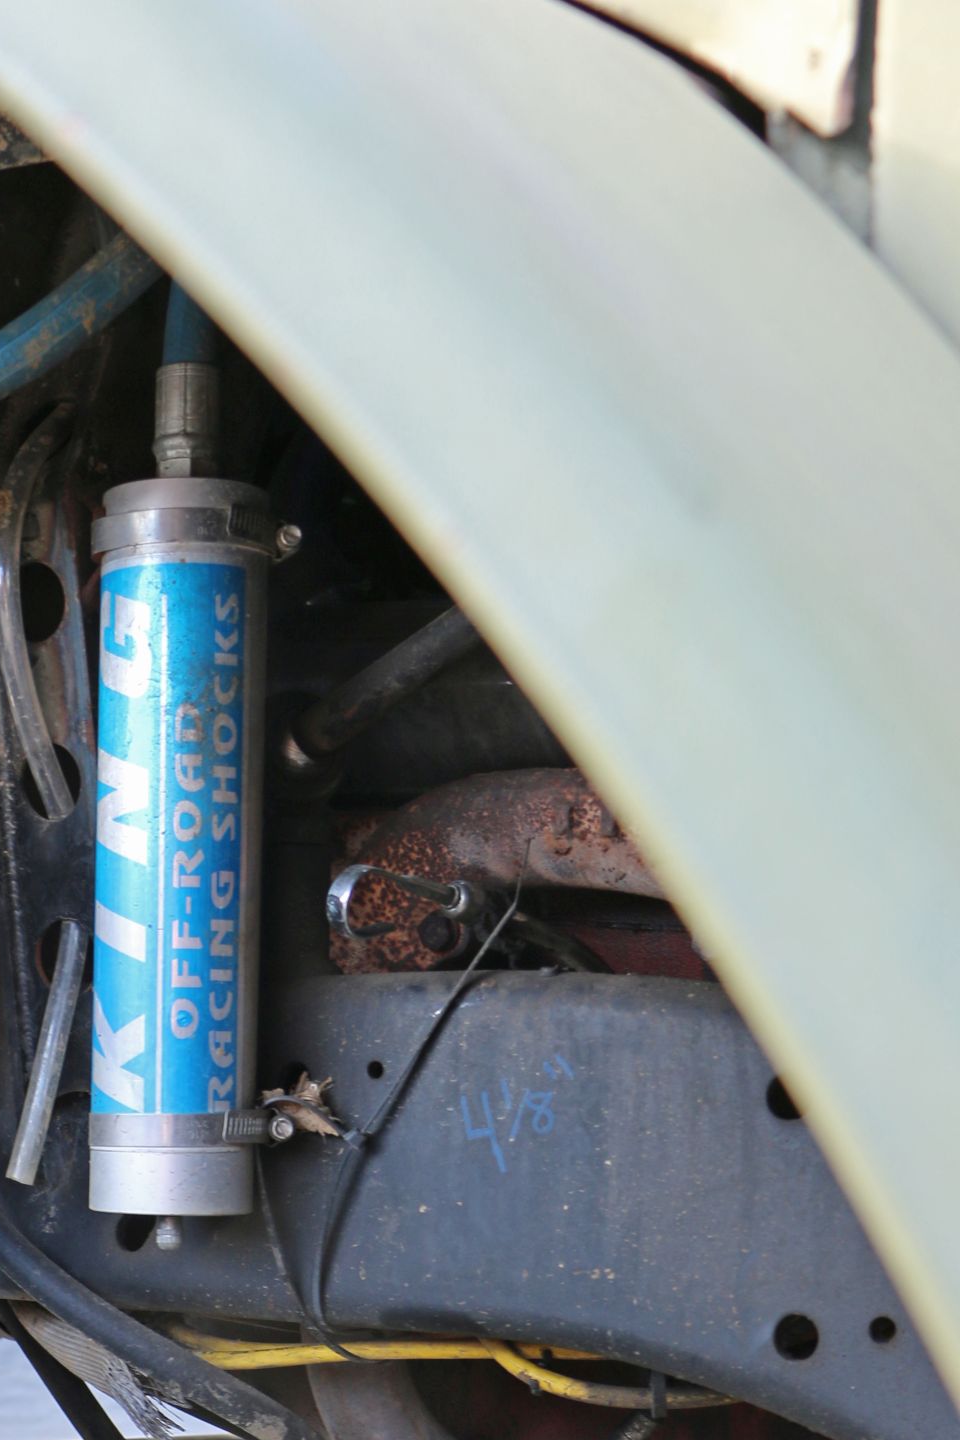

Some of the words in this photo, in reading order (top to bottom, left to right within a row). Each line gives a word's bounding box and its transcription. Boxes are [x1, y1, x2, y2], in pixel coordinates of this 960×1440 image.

[92, 590, 153, 1113] KING
[212, 593, 239, 842] SHOCKS
[171, 702, 205, 1039] OFF-ROAD
[208, 870, 235, 1113] RACING
